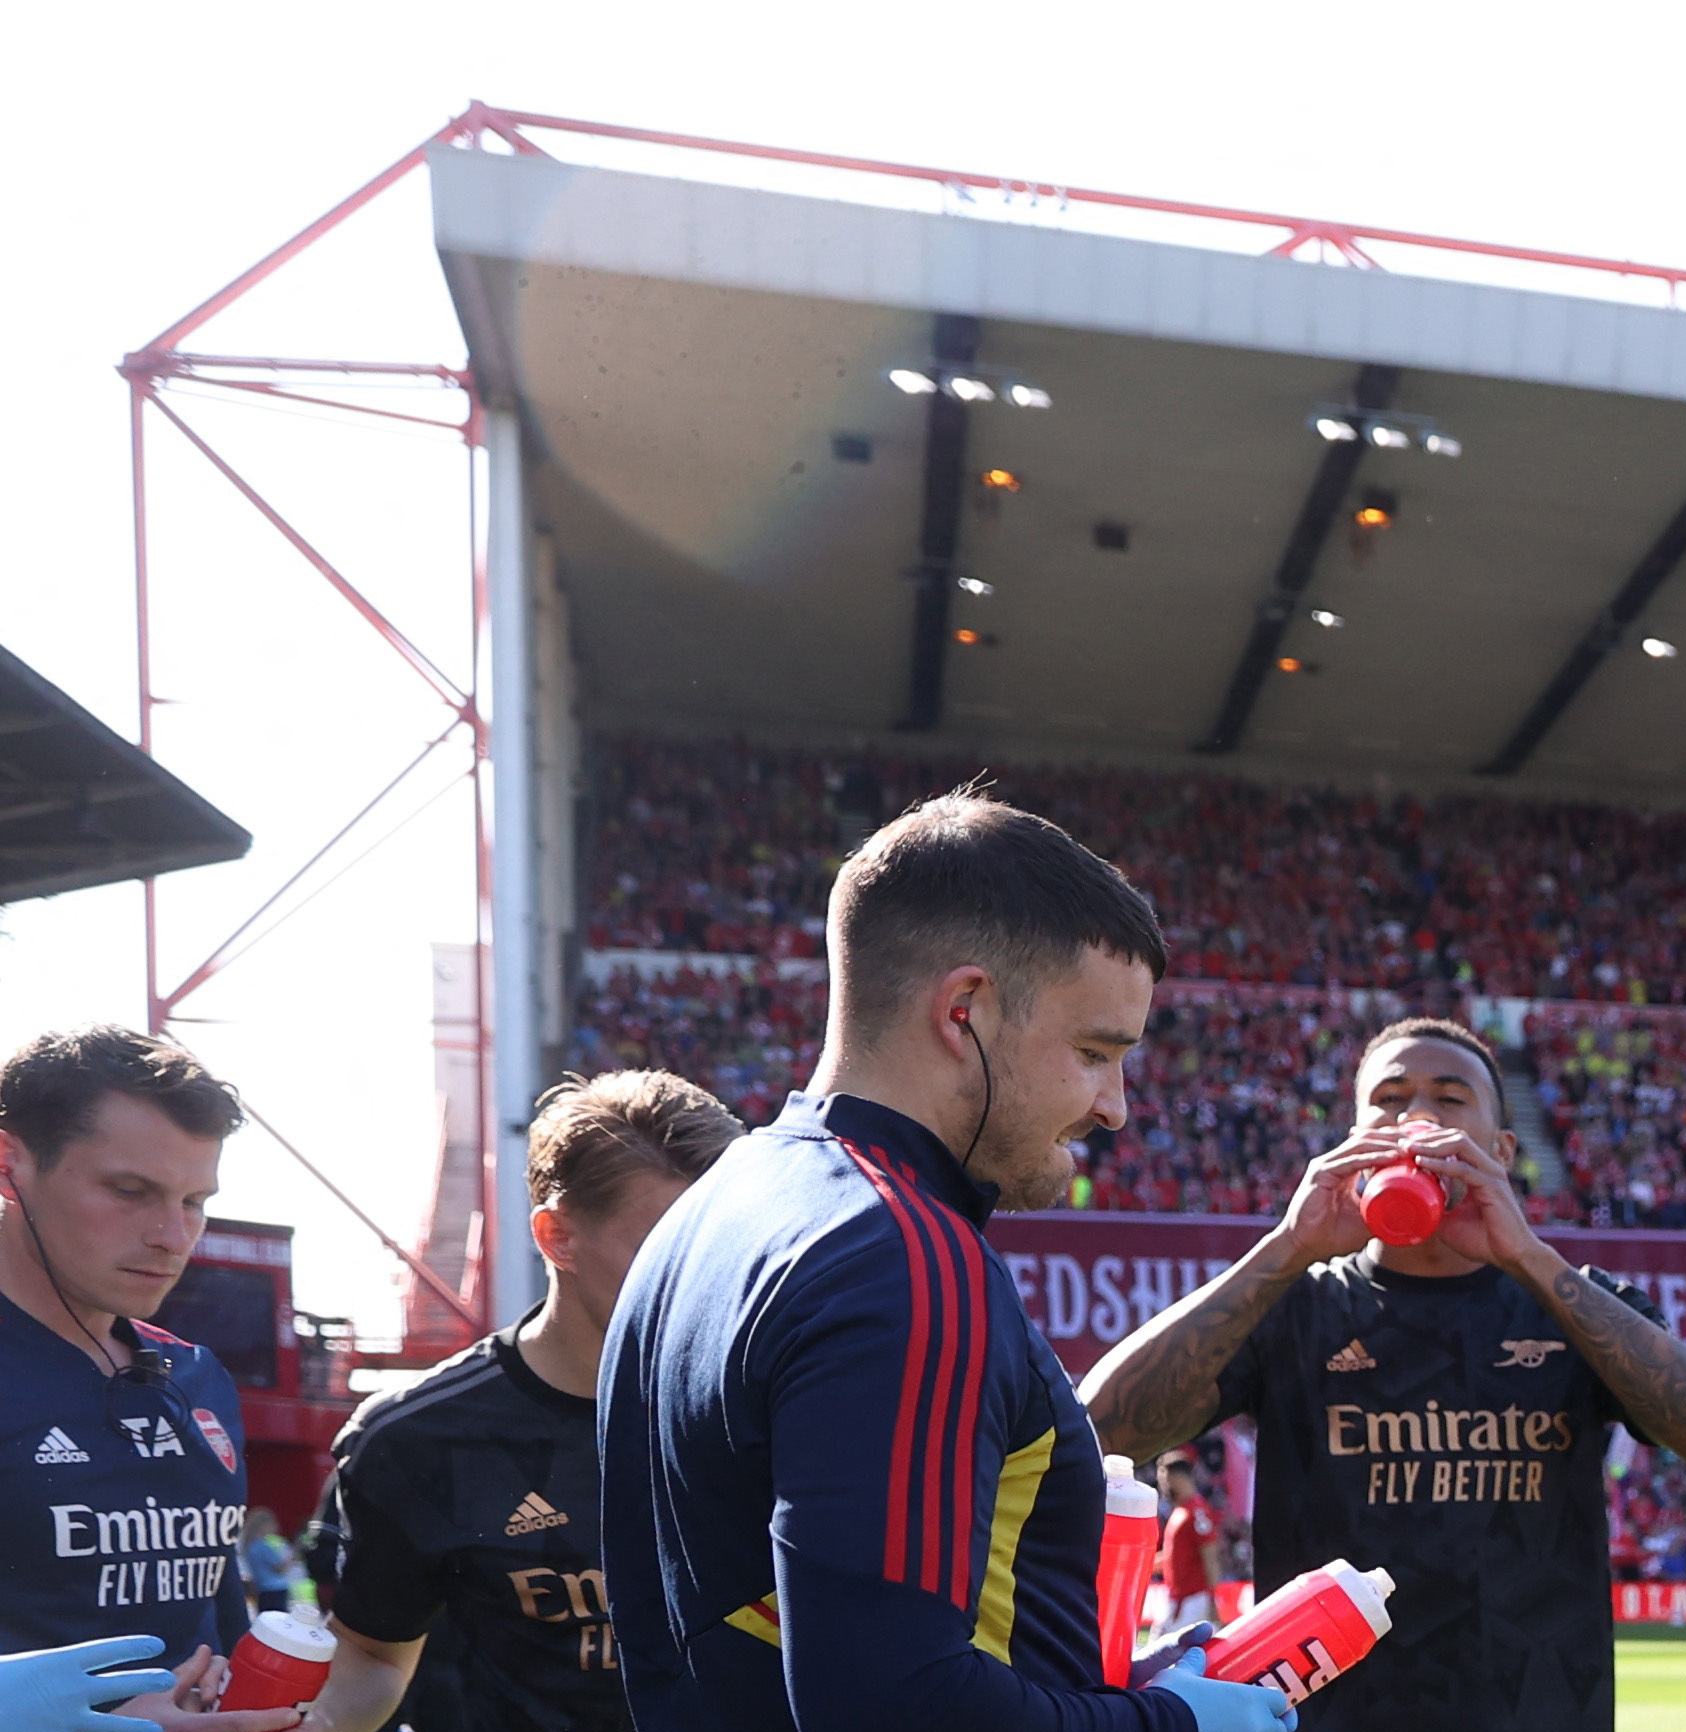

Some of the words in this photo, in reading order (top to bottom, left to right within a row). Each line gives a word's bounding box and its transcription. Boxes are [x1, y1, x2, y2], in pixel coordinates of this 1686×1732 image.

[119, 1415, 186, 1458] TA
[1326, 1399, 1572, 1456] Emirates
[35, 1449, 90, 1464] adidas
[1367, 1461, 1421, 1505] FLY
[1431, 1459, 1543, 1503] BETTER
[504, 1511, 570, 1537] adidas
[98, 1561, 147, 1607] FLY
[579, 1622, 618, 1671] FL
